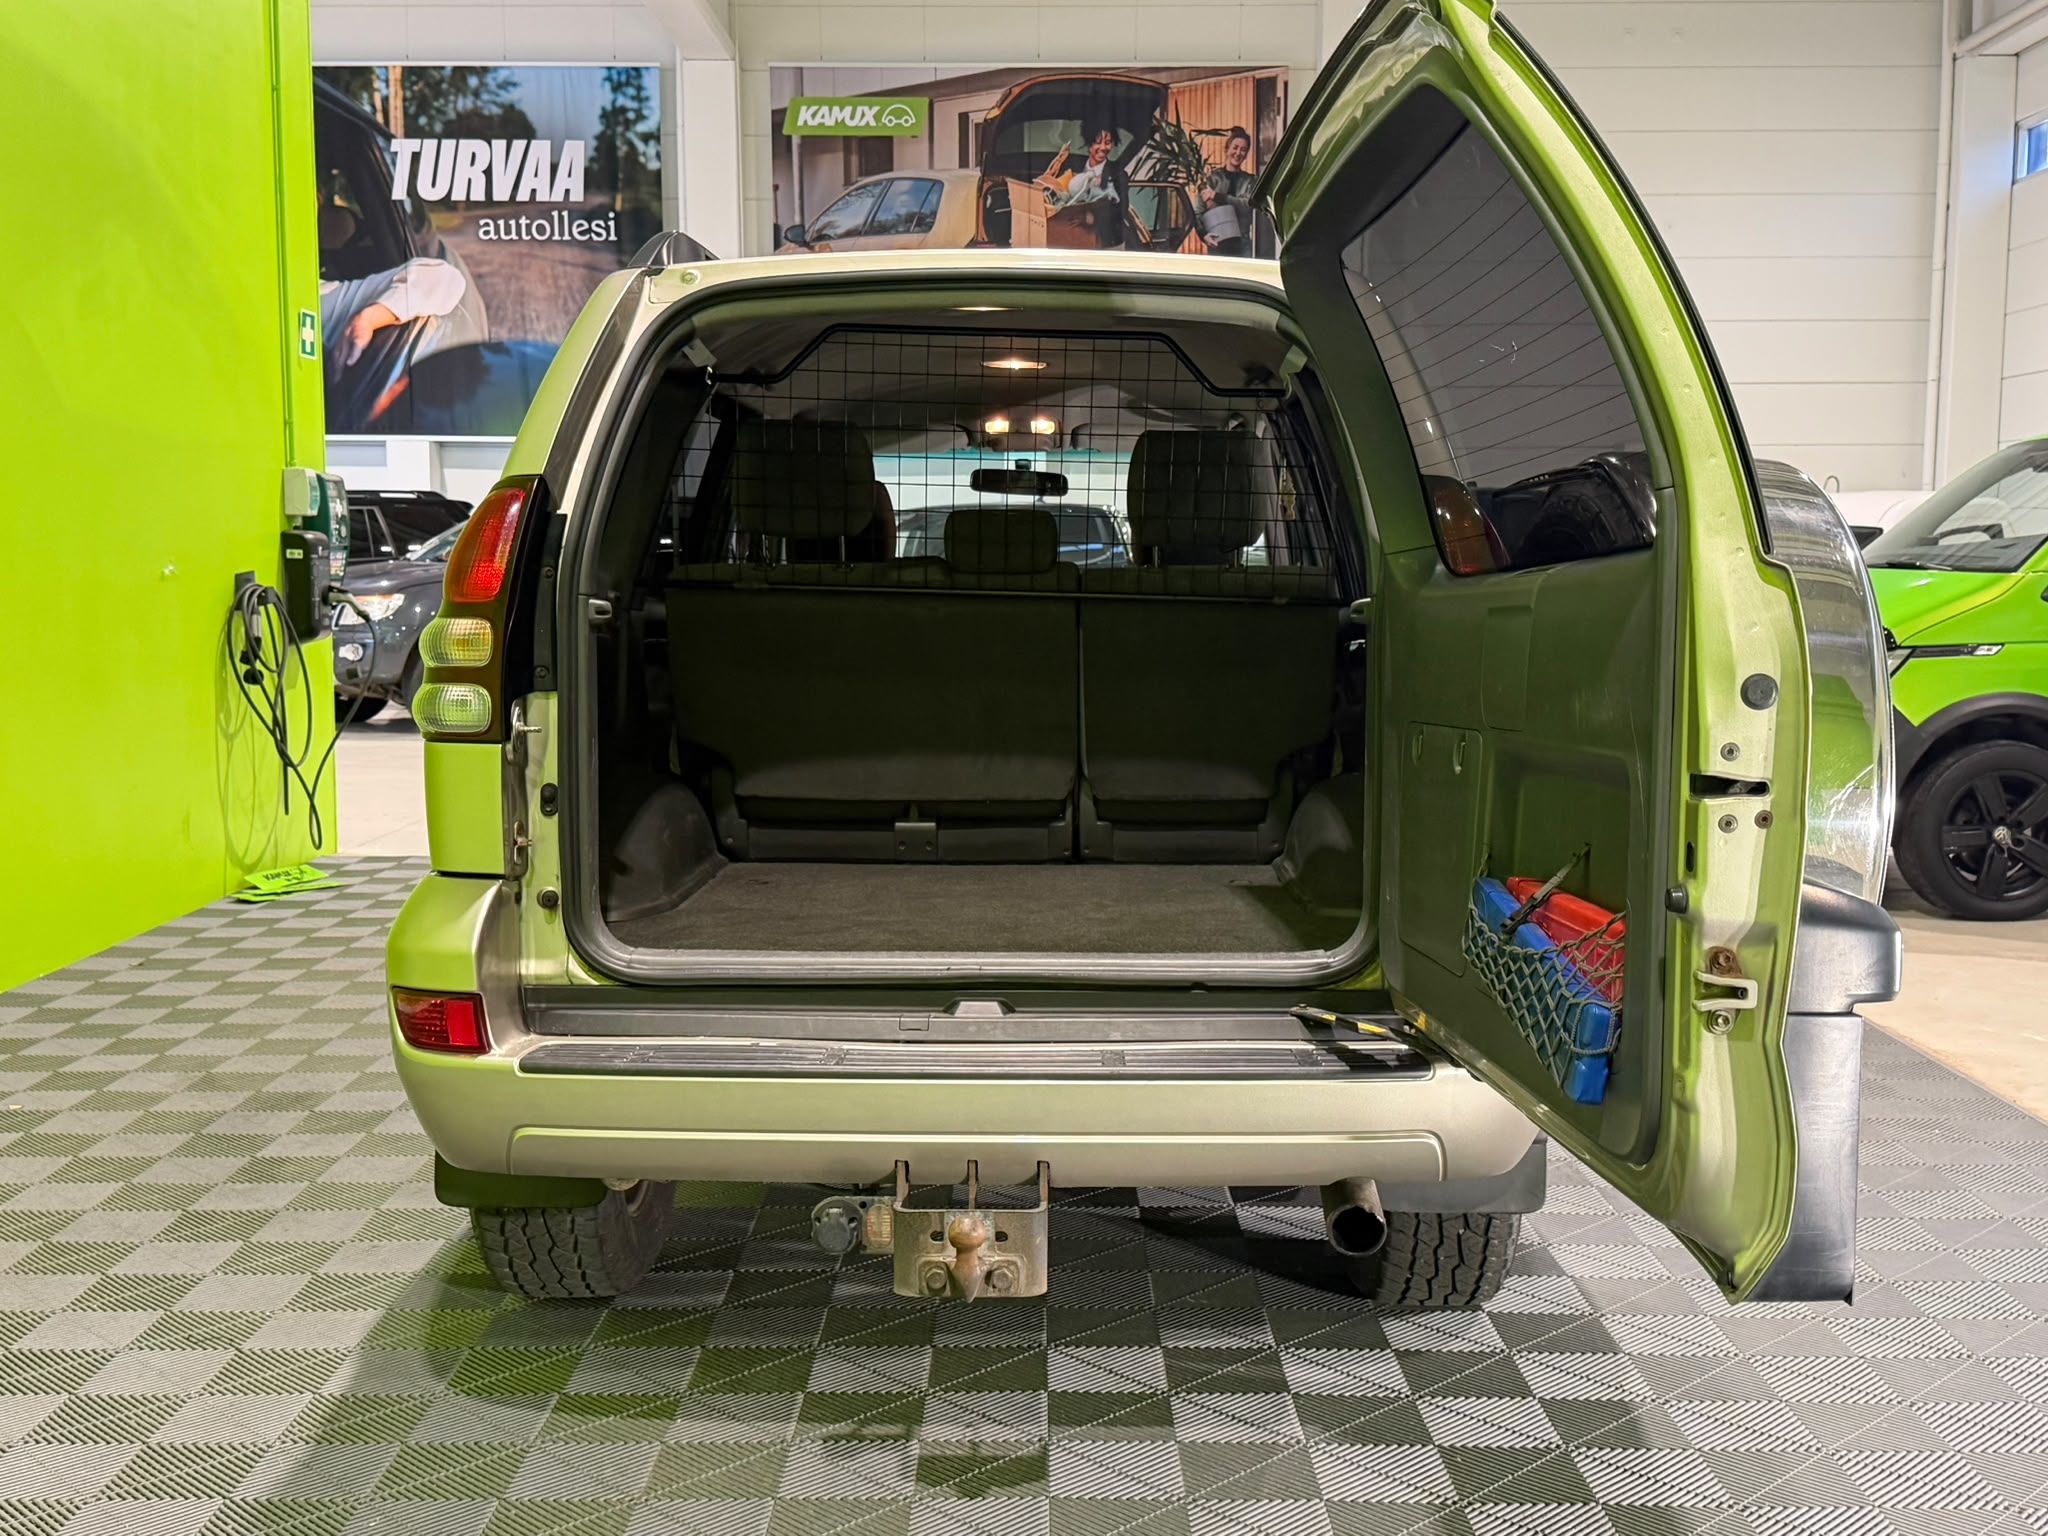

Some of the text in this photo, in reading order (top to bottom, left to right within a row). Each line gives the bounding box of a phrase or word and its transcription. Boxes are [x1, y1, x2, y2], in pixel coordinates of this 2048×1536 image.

[797, 105, 880, 126] KAMUX
[390, 138, 585, 202] TURVAA
[478, 210, 617, 241] autollesi
